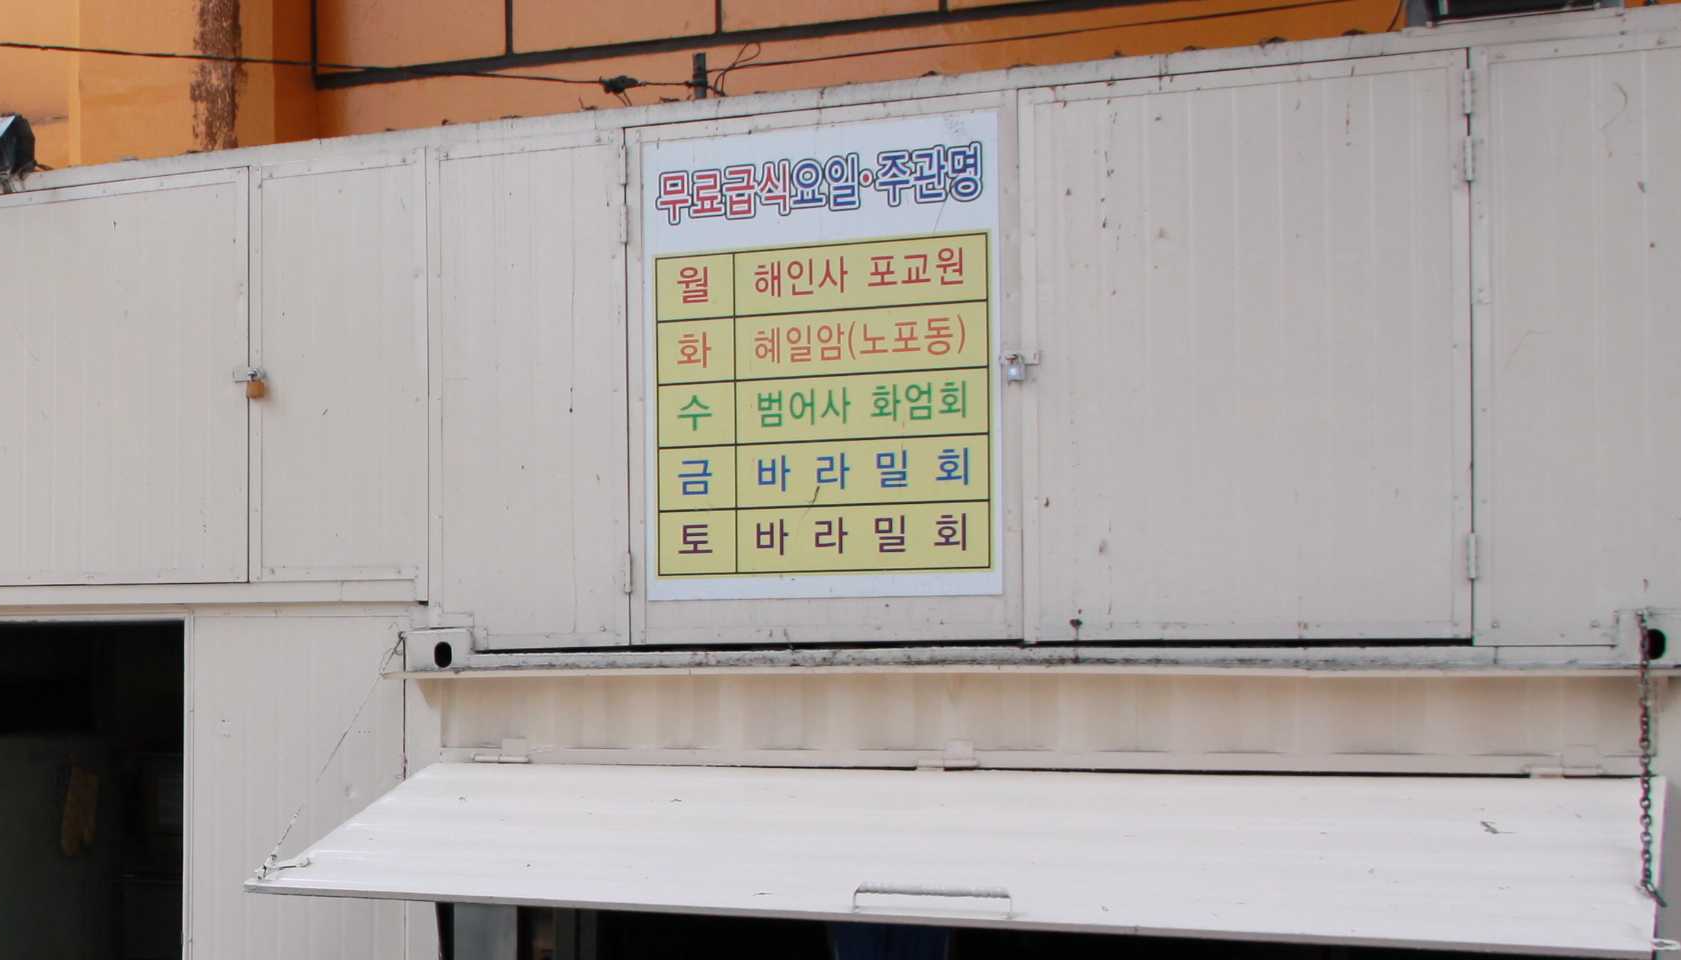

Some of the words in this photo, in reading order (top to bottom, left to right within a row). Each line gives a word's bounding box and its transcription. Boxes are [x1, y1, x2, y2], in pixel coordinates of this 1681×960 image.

[677, 265, 710, 304] 월
[754, 256, 848, 298] 해인사
[867, 247, 965, 287] 포교원
[676, 331, 712, 368] 화
[677, 394, 713, 432] 수
[757, 386, 851, 428] 범어사
[870, 380, 968, 422] 화엄회
[677, 459, 713, 496] 금
[677, 523, 714, 555] 토
